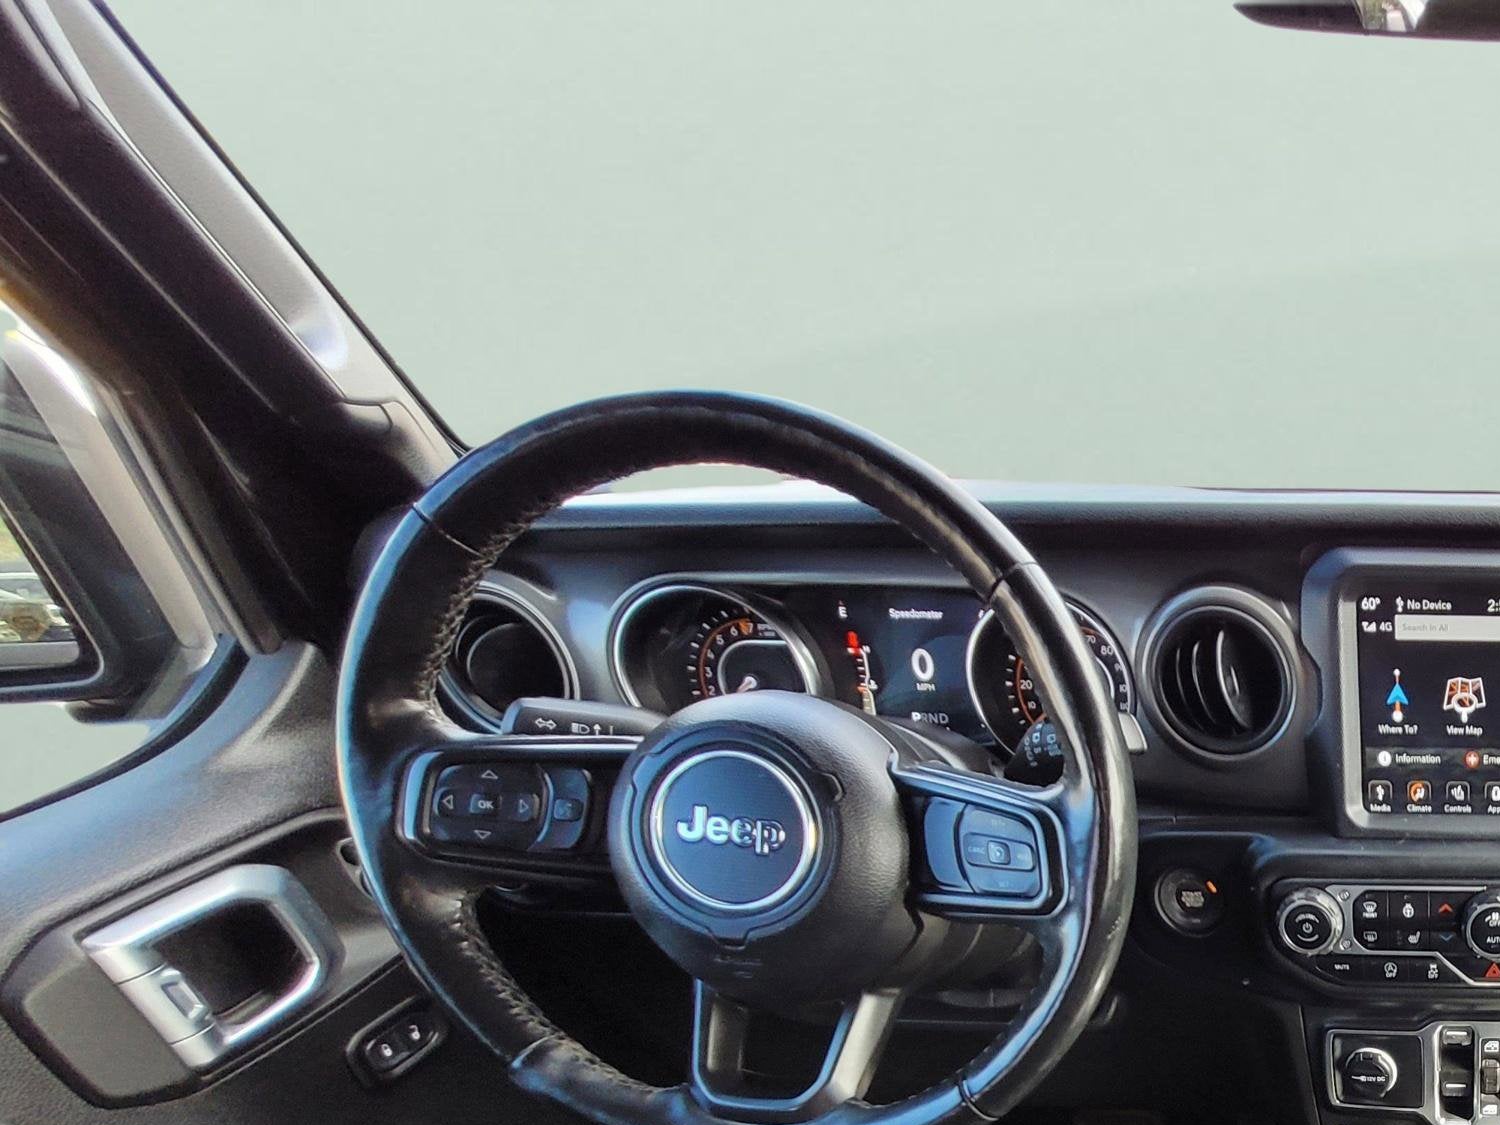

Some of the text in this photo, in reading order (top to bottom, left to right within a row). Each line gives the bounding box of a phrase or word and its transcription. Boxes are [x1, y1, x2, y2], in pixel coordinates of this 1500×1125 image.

[1406, 599, 1452, 611] No Device
[838, 606, 848, 618] E
[888, 607, 944, 620] Speedometer
[730, 626, 738, 636] 6
[1379, 622, 1393, 632] 4G
[716, 635, 724, 645] 5
[1100, 646, 1114, 655] 80
[911, 648, 934, 682] 0
[704, 666, 713, 677] 3
[916, 682, 936, 692] MPH
[1020, 679, 1033, 690] 20
[708, 685, 716, 695] 2
[1027, 700, 1037, 709] 10
[1378, 724, 1418, 735] Where To?
[1446, 724, 1483, 737] View Map
[1395, 753, 1441, 764] Information
[478, 799, 494, 810] OK
[1369, 803, 1392, 813] Media
[1406, 803, 1432, 813] Climate
[1444, 804, 1472, 814] Controls
[676, 804, 786, 856] Jeep
[1334, 963, 1350, 971] MUTE
